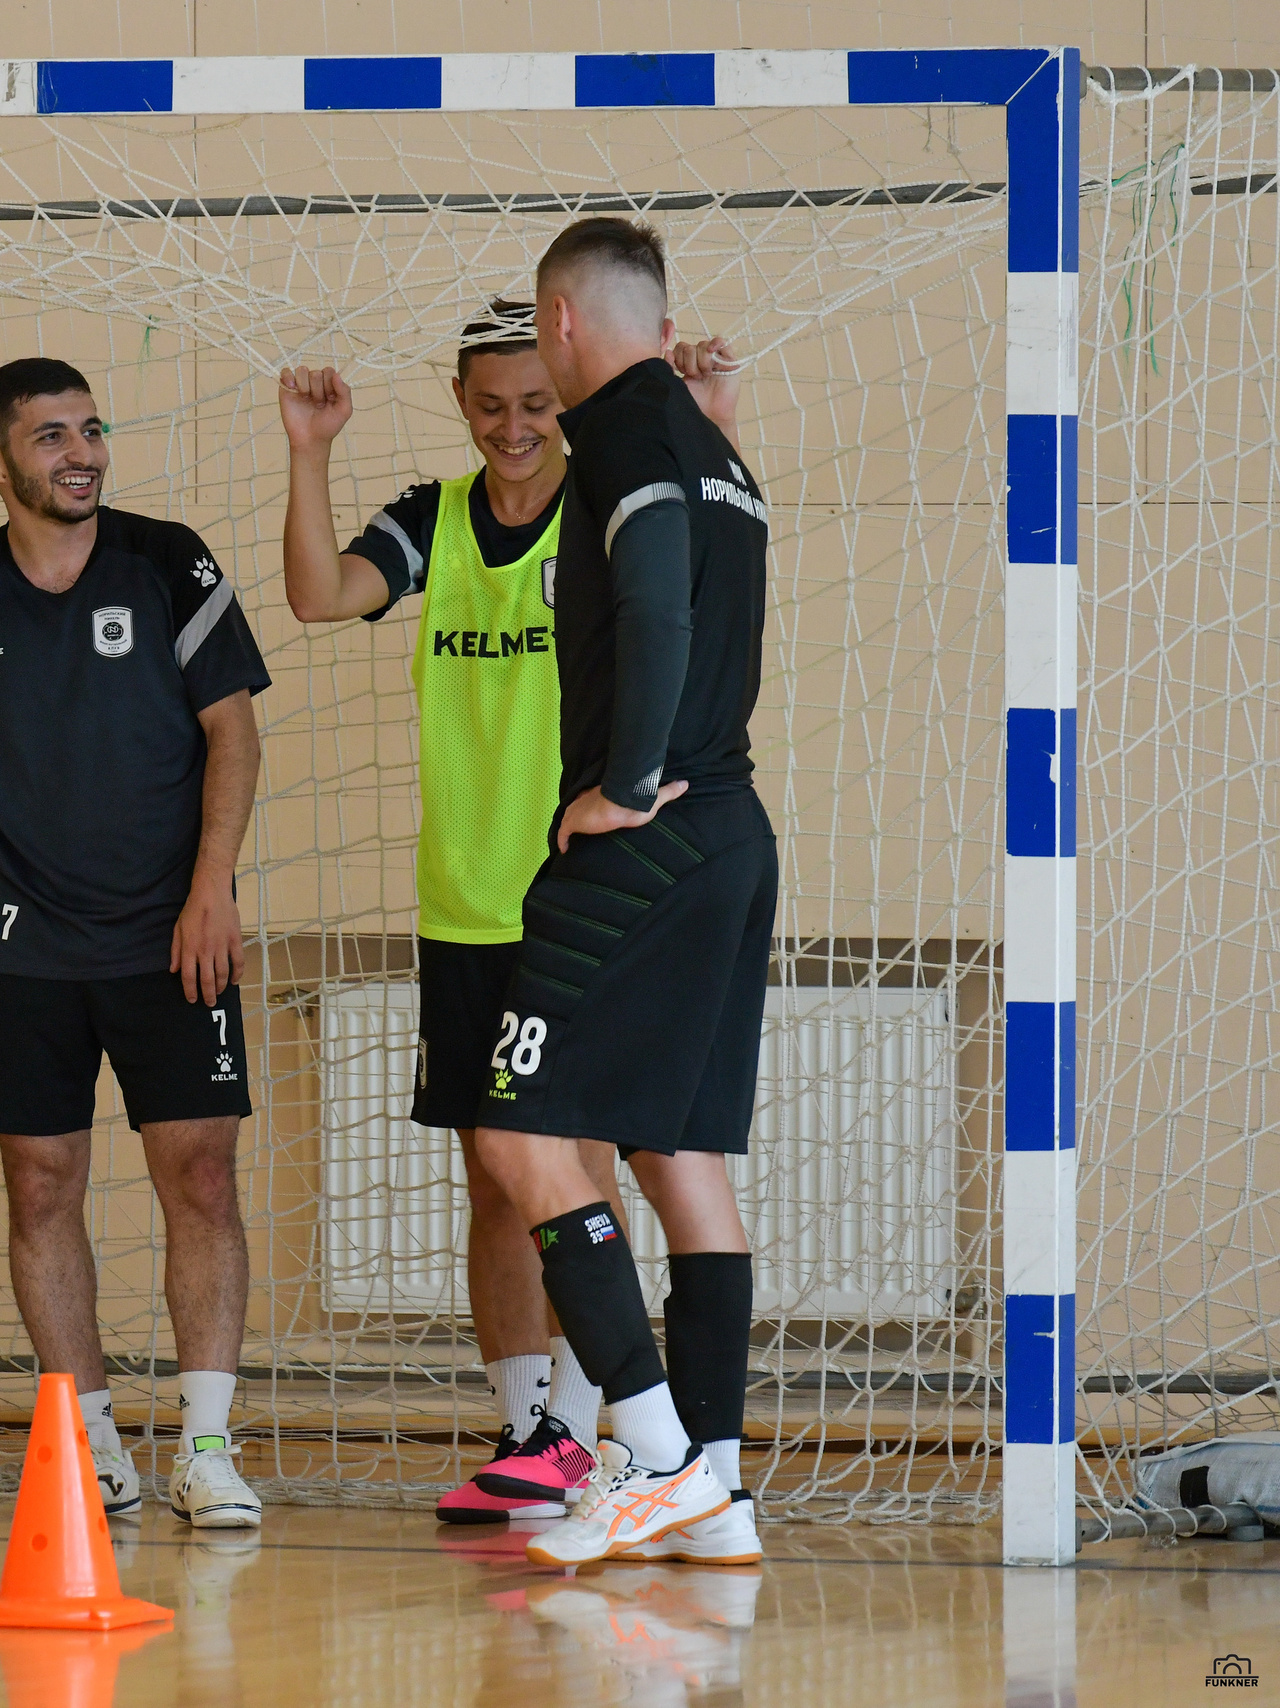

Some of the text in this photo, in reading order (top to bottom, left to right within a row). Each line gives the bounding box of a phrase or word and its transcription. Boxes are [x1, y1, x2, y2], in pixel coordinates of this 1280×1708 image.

[434, 626, 549, 658] KELME
[1, 903, 20, 940] 7
[211, 1009, 227, 1046] 7
[490, 1010, 548, 1076] 28
[211, 1073, 238, 1082] KELME
[488, 1089, 517, 1101] KELME
[584, 1212, 612, 1233] SHEVA
[589, 1229, 604, 1245] 35
